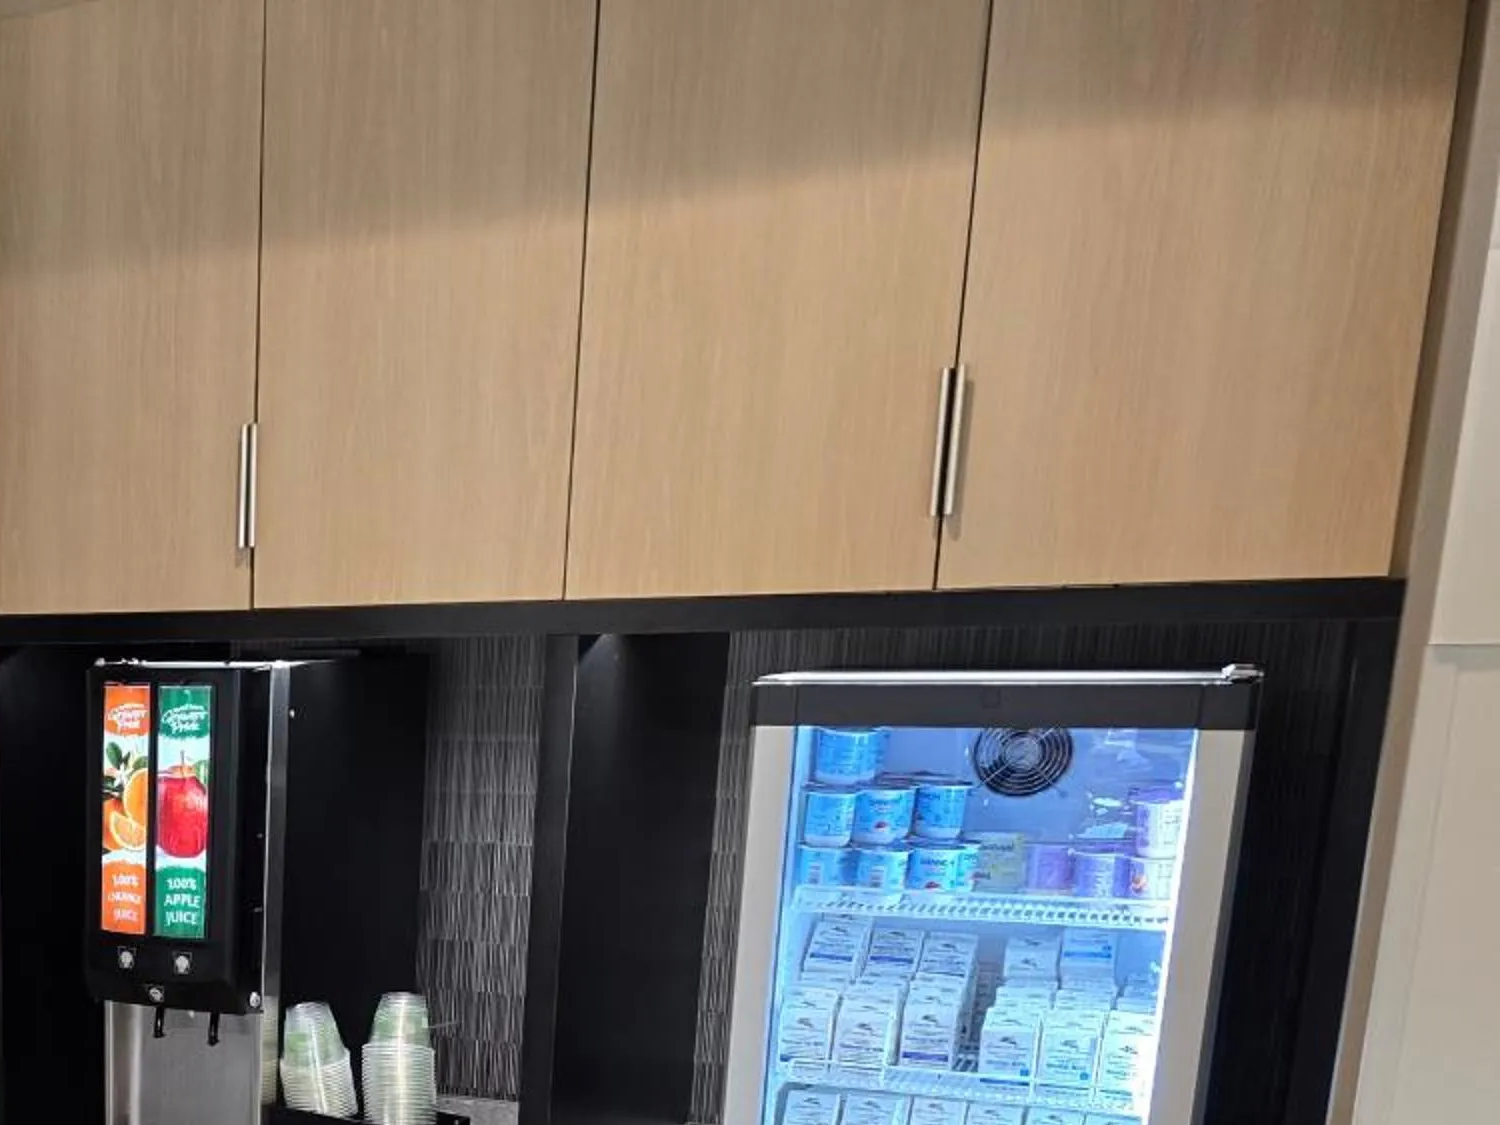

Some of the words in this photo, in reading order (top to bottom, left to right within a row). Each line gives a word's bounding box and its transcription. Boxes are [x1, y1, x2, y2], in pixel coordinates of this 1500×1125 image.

[166, 877, 197, 890] 100%
[164, 893, 201, 909] APPLE
[165, 911, 197, 926] JUICE
